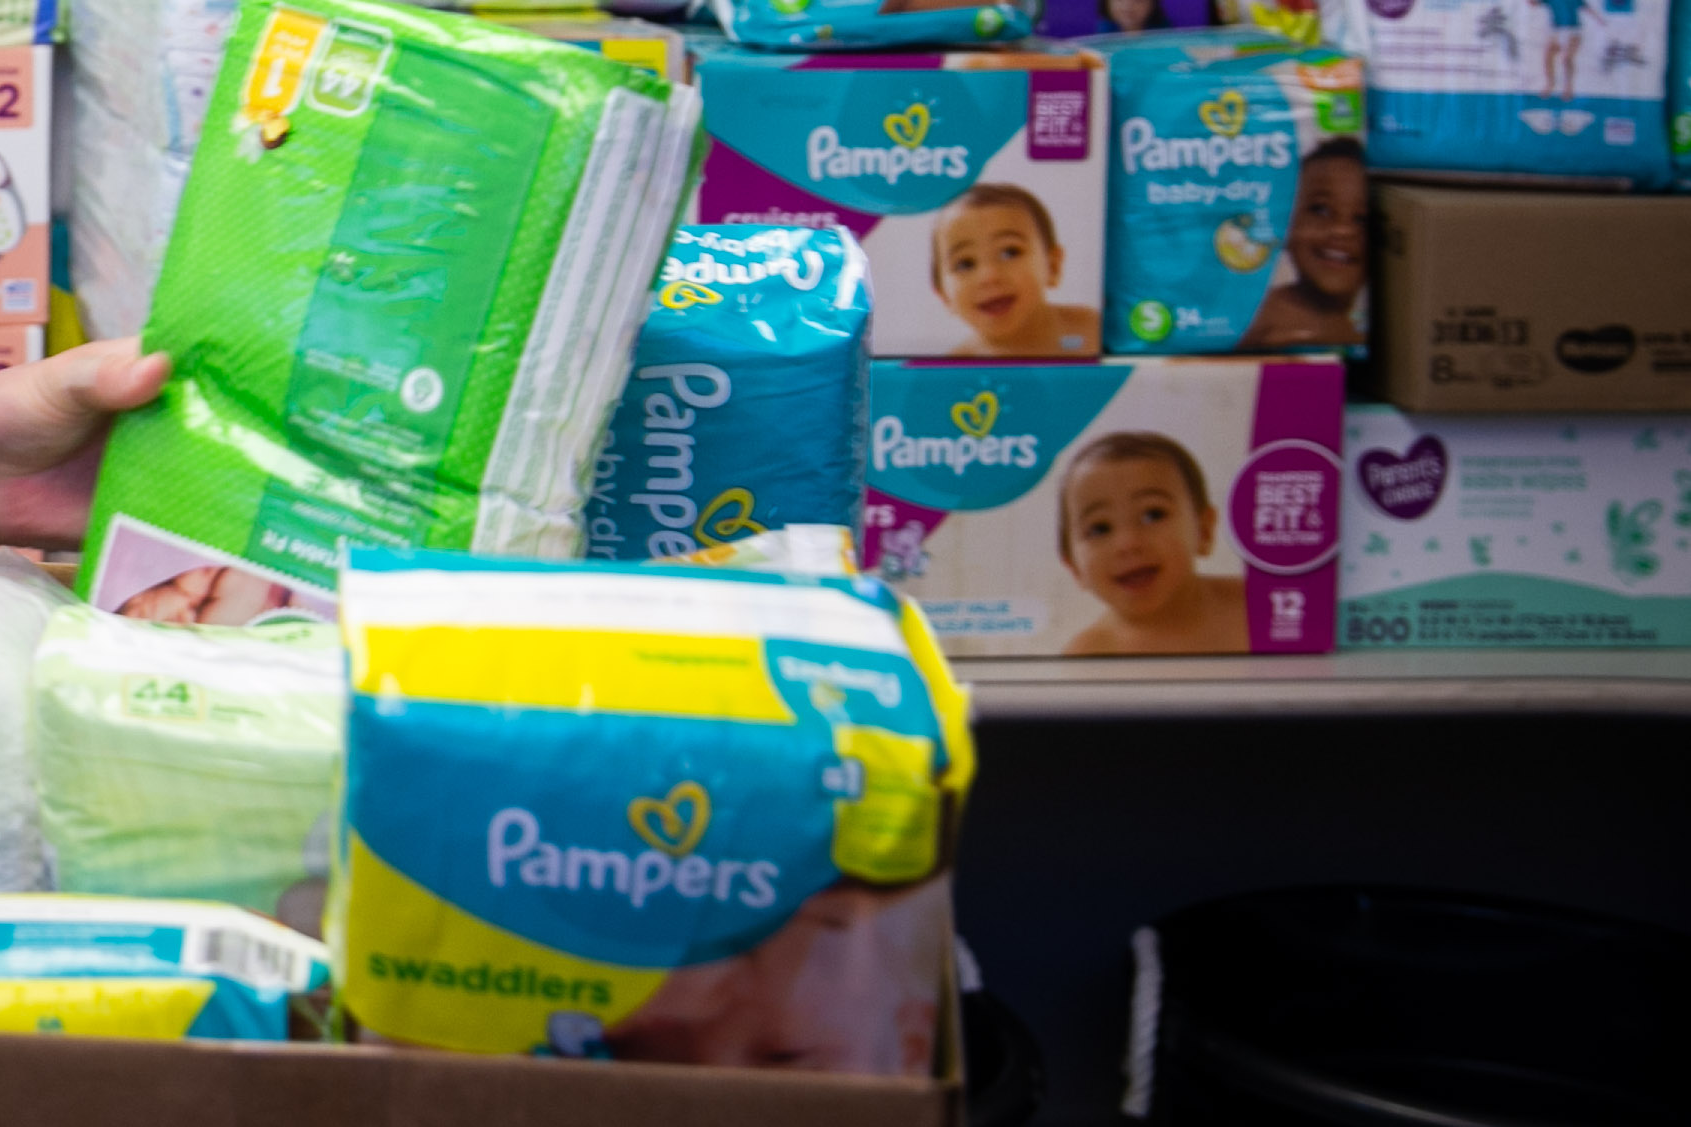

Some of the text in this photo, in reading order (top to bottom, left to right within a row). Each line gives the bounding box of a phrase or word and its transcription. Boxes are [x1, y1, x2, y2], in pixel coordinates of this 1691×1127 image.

[807, 125, 969, 185] Pampers
[1121, 116, 1292, 177] Pampers
[1146, 179, 1271, 205] baby-dry
[661, 250, 825, 291] Pampe
[1140, 304, 1164, 331] 5
[637, 363, 732, 560] Pampe
[873, 415, 1039, 477] Pampers
[1255, 483, 1323, 506] BEST
[1254, 506, 1302, 531] FIT
[1270, 590, 1306, 617] 12
[1346, 617, 1410, 642] 800
[133, 680, 191, 704] 44
[487, 807, 781, 909] Pampers
[367, 952, 613, 1009] swaddlers
